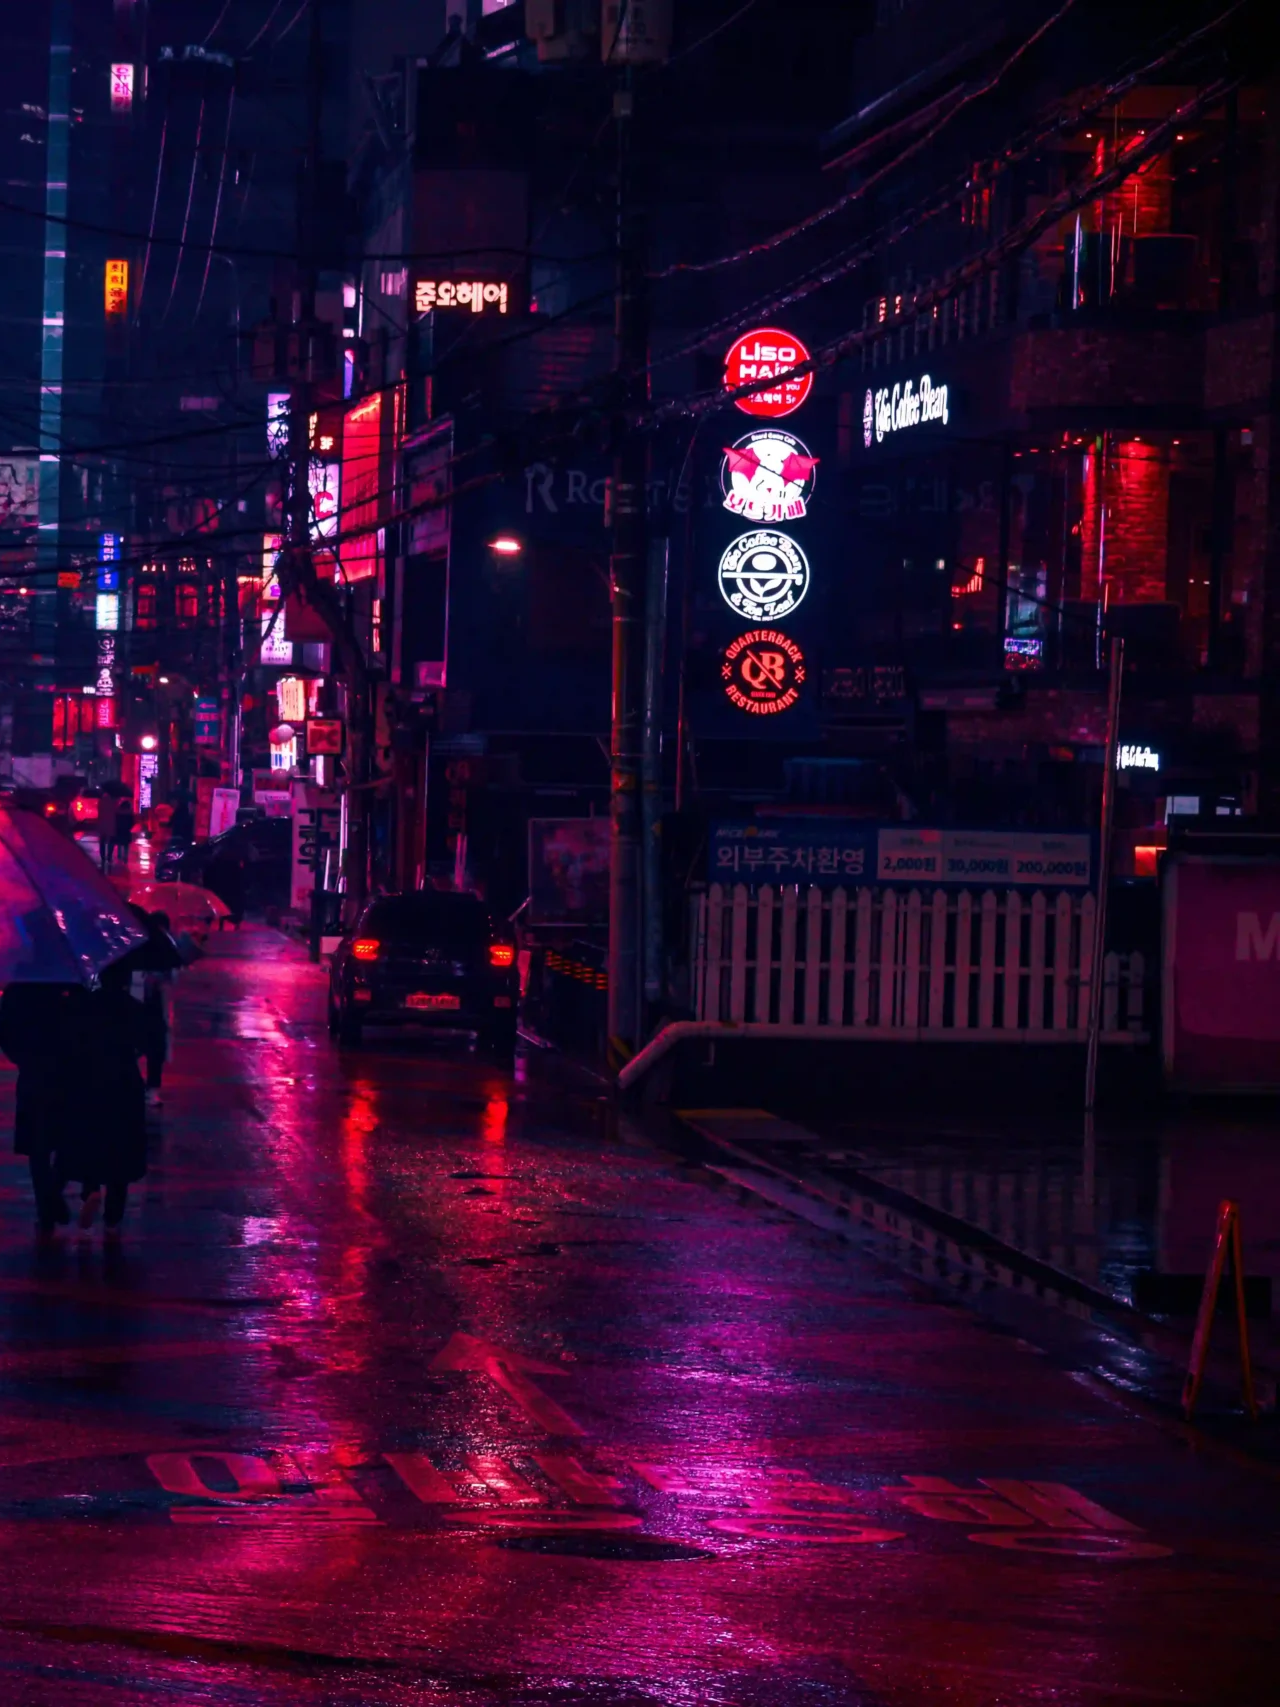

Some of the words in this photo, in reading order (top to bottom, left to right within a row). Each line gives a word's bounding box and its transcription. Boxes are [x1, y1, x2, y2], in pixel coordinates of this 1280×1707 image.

[414, 280, 509, 313] 준오헤어
[725, 630, 803, 663] QUARTERBACK
[725, 684, 799, 715] RESTAURANT
[715, 844, 866, 875] 외부주차환영
[883, 856, 937, 873] 2,000원
[947, 858, 1010, 875] 30,000원
[1016, 860, 1087, 877] 200,000원
